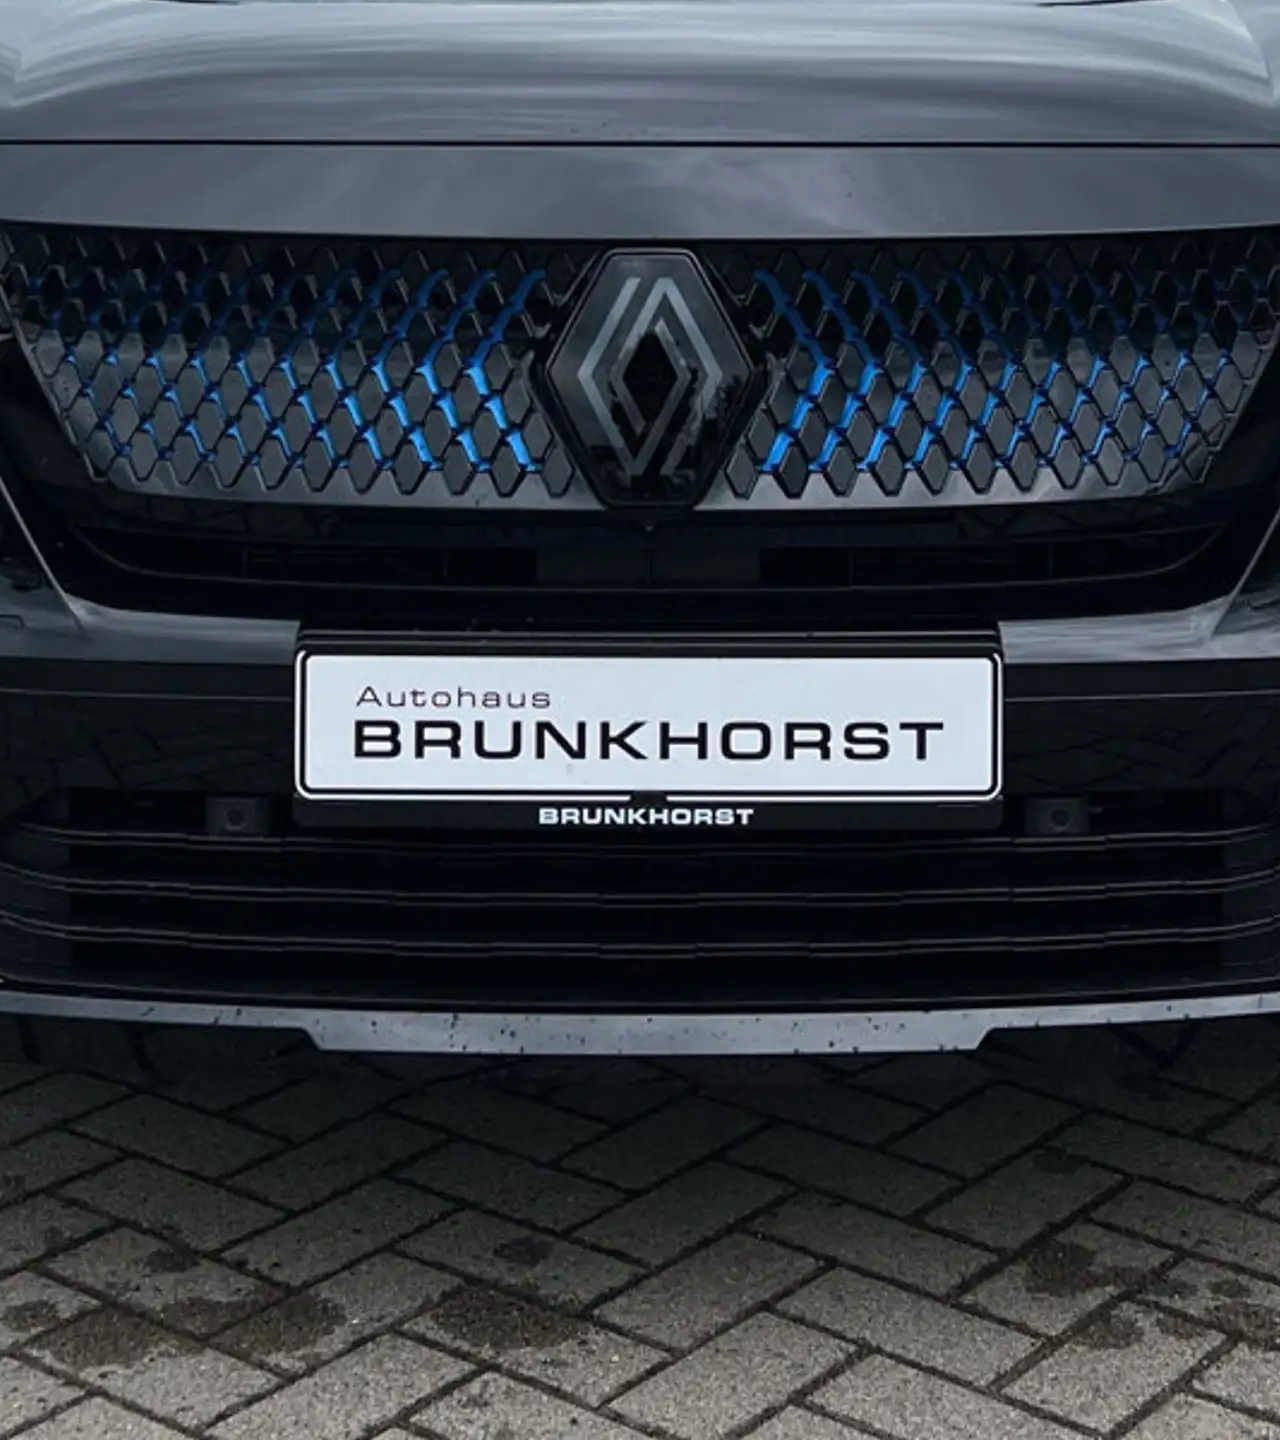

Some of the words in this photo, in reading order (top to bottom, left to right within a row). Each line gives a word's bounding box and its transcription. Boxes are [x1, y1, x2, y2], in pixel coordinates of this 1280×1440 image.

[356, 686, 551, 709] Autohaus
[354, 720, 945, 761] BRUNKHORST
[539, 807, 755, 826] BRUNKHORST
